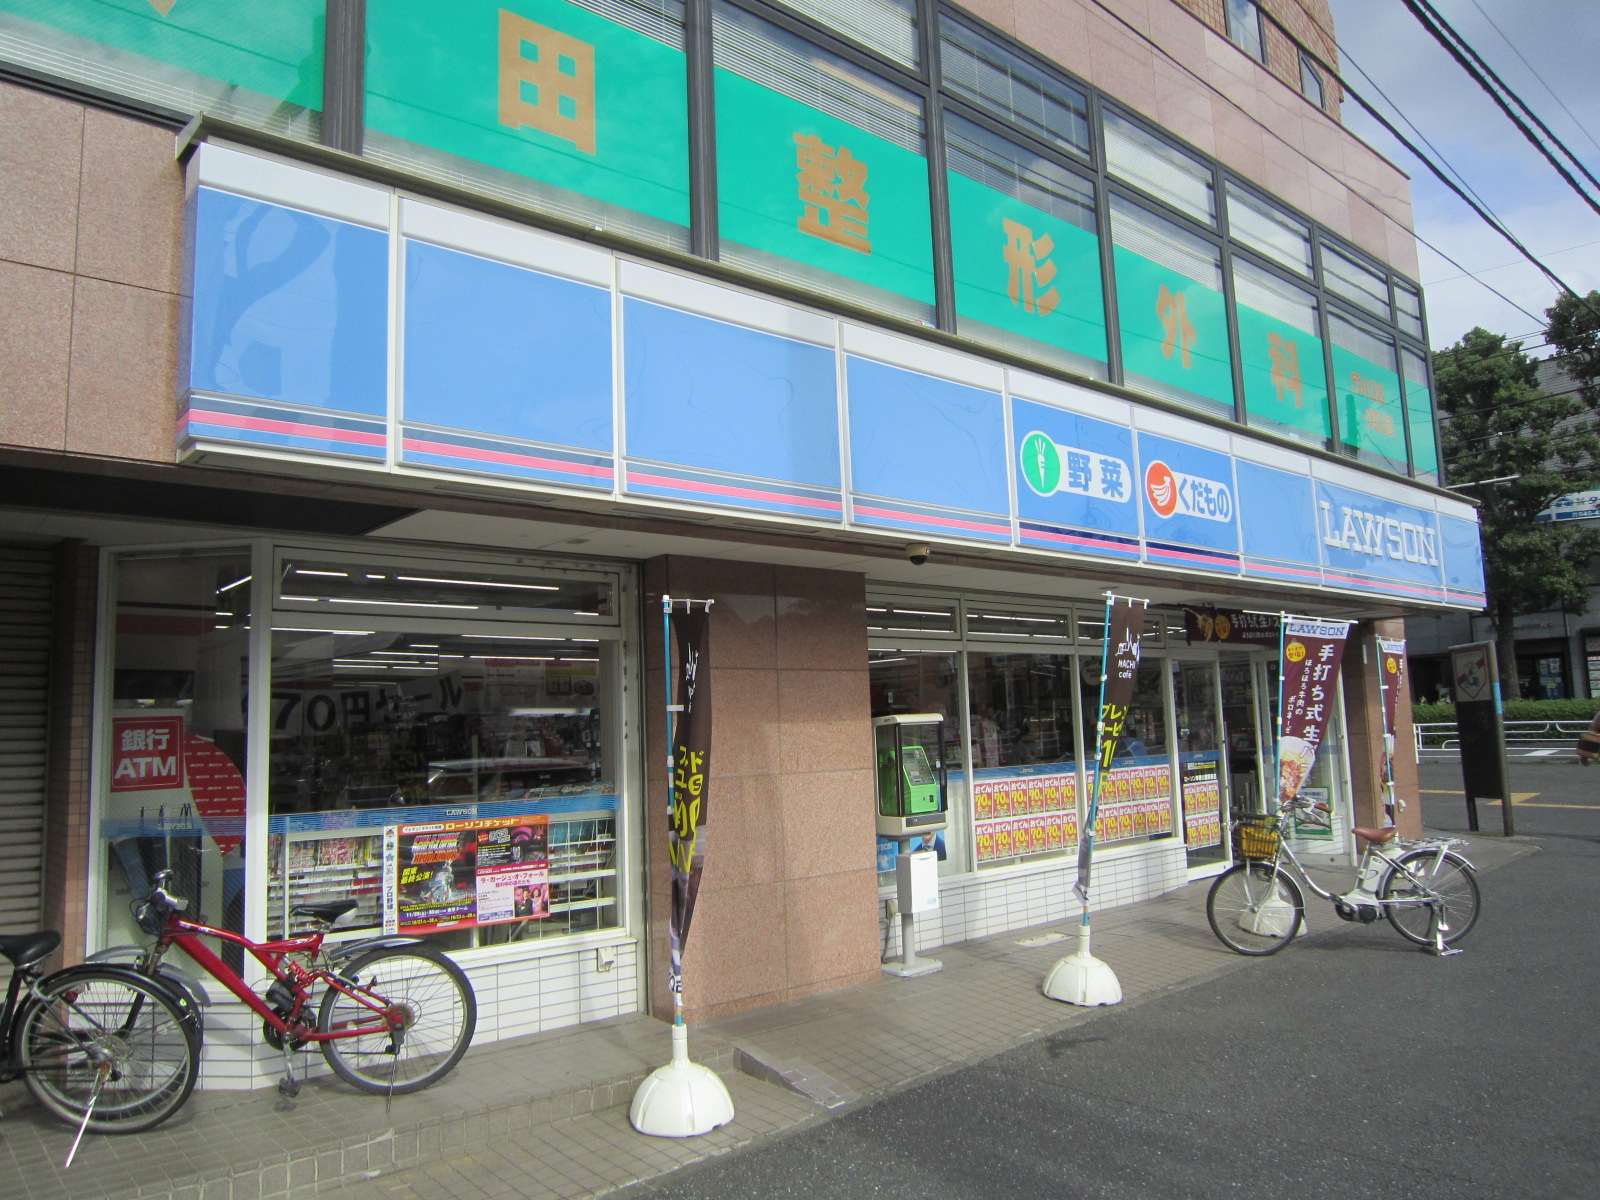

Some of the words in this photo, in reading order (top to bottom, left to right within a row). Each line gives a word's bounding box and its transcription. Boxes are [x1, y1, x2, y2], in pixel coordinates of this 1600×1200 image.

[498, 7, 596, 155] 田
[793, 131, 871, 255] 整
[1002, 217, 1061, 317] 形
[1155, 284, 1197, 369] 外
[1267, 332, 1303, 408] 科
[1067, 451, 1125, 499] 野菜
[1177, 476, 1230, 520] くだもの
[1320, 500, 1439, 567] LAWSON
[1288, 623, 1346, 636] LAWSON
[1118, 659, 1136, 670] MACHI
[1118, 670, 1132, 679] café
[122, 728, 170, 752] 銀行
[114, 756, 176, 779] ATM
[975, 786, 992, 794] おでん
[994, 784, 1008, 792] おでん
[446, 808, 478, 816] LAWSON
[445, 818, 520, 831] ローソンチケット
[977, 826, 992, 835] おでん
[995, 824, 1011, 832] おでん
[1013, 821, 1029, 830] おでん
